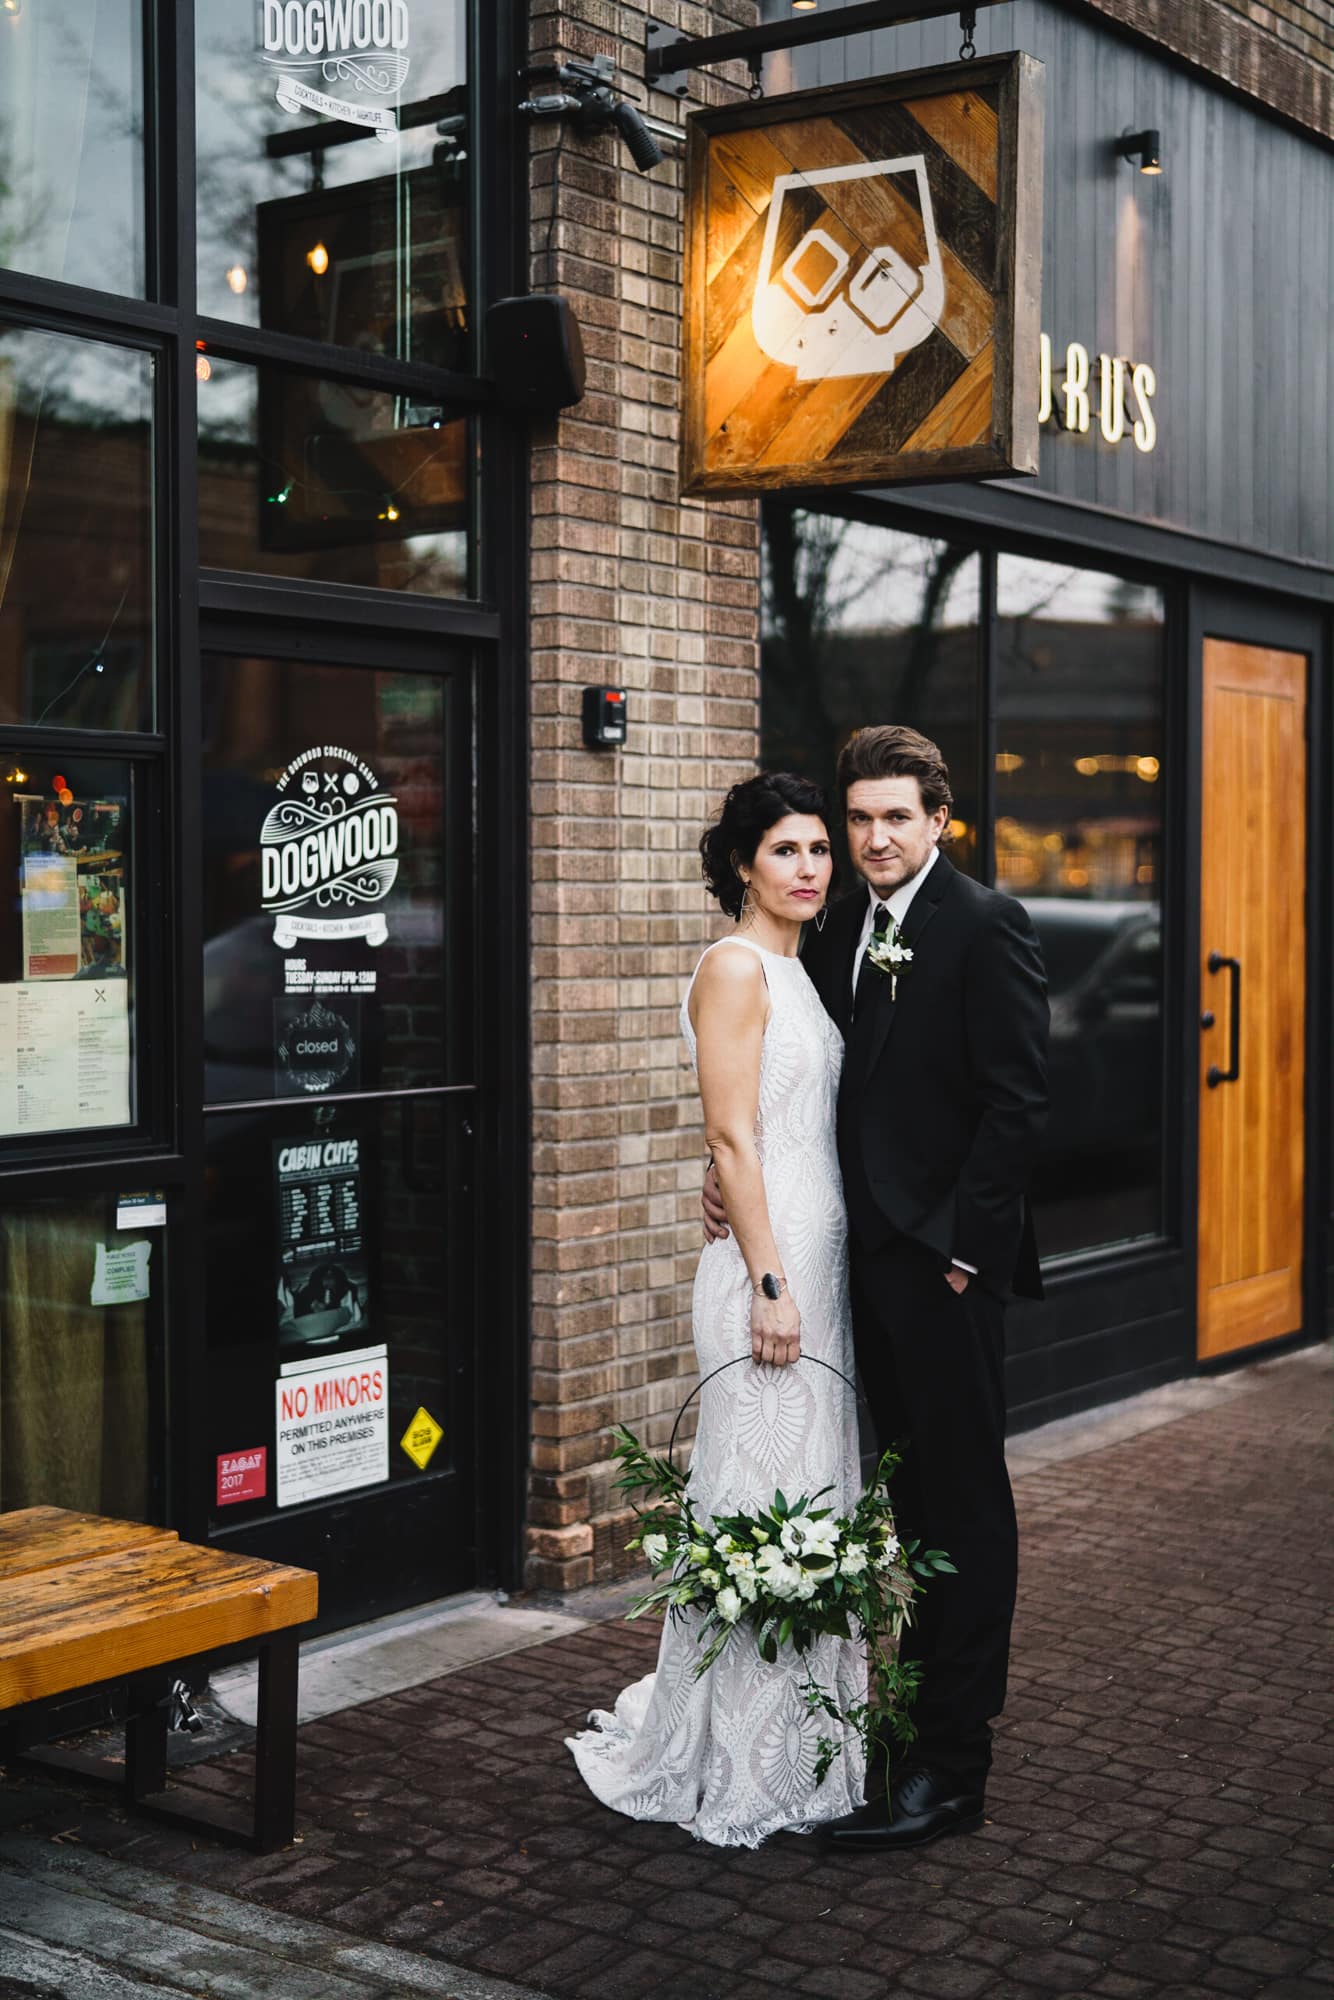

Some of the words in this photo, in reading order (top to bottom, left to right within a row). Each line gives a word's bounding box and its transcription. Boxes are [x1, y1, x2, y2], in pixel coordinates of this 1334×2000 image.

[263, 0, 409, 55] DOGWOOD
[294, 85, 323, 108] COCKTAILS
[328, 101, 351, 116] KITCHEN
[275, 771, 291, 792] THE
[287, 746, 322, 776] DOGWOOD
[323, 745, 359, 768] COCKTAIL
[358, 761, 379, 790] CABIN
[262, 806, 399, 899] DOGWOOD
[296, 1038, 339, 1055] closed
[278, 1143, 322, 1173] CABIN
[323, 1138, 359, 1167] CUTS
[281, 1386, 308, 1422] NO
[314, 1370, 383, 1415] MINORS
[280, 1420, 333, 1442] PERMITTED
[334, 1408, 385, 1429] ANYWHERE
[291, 1442, 306, 1455] ON
[307, 1436, 328, 1452] THIS
[329, 1426, 375, 1446] PREMISES
[221, 1474, 244, 1489] 2017
